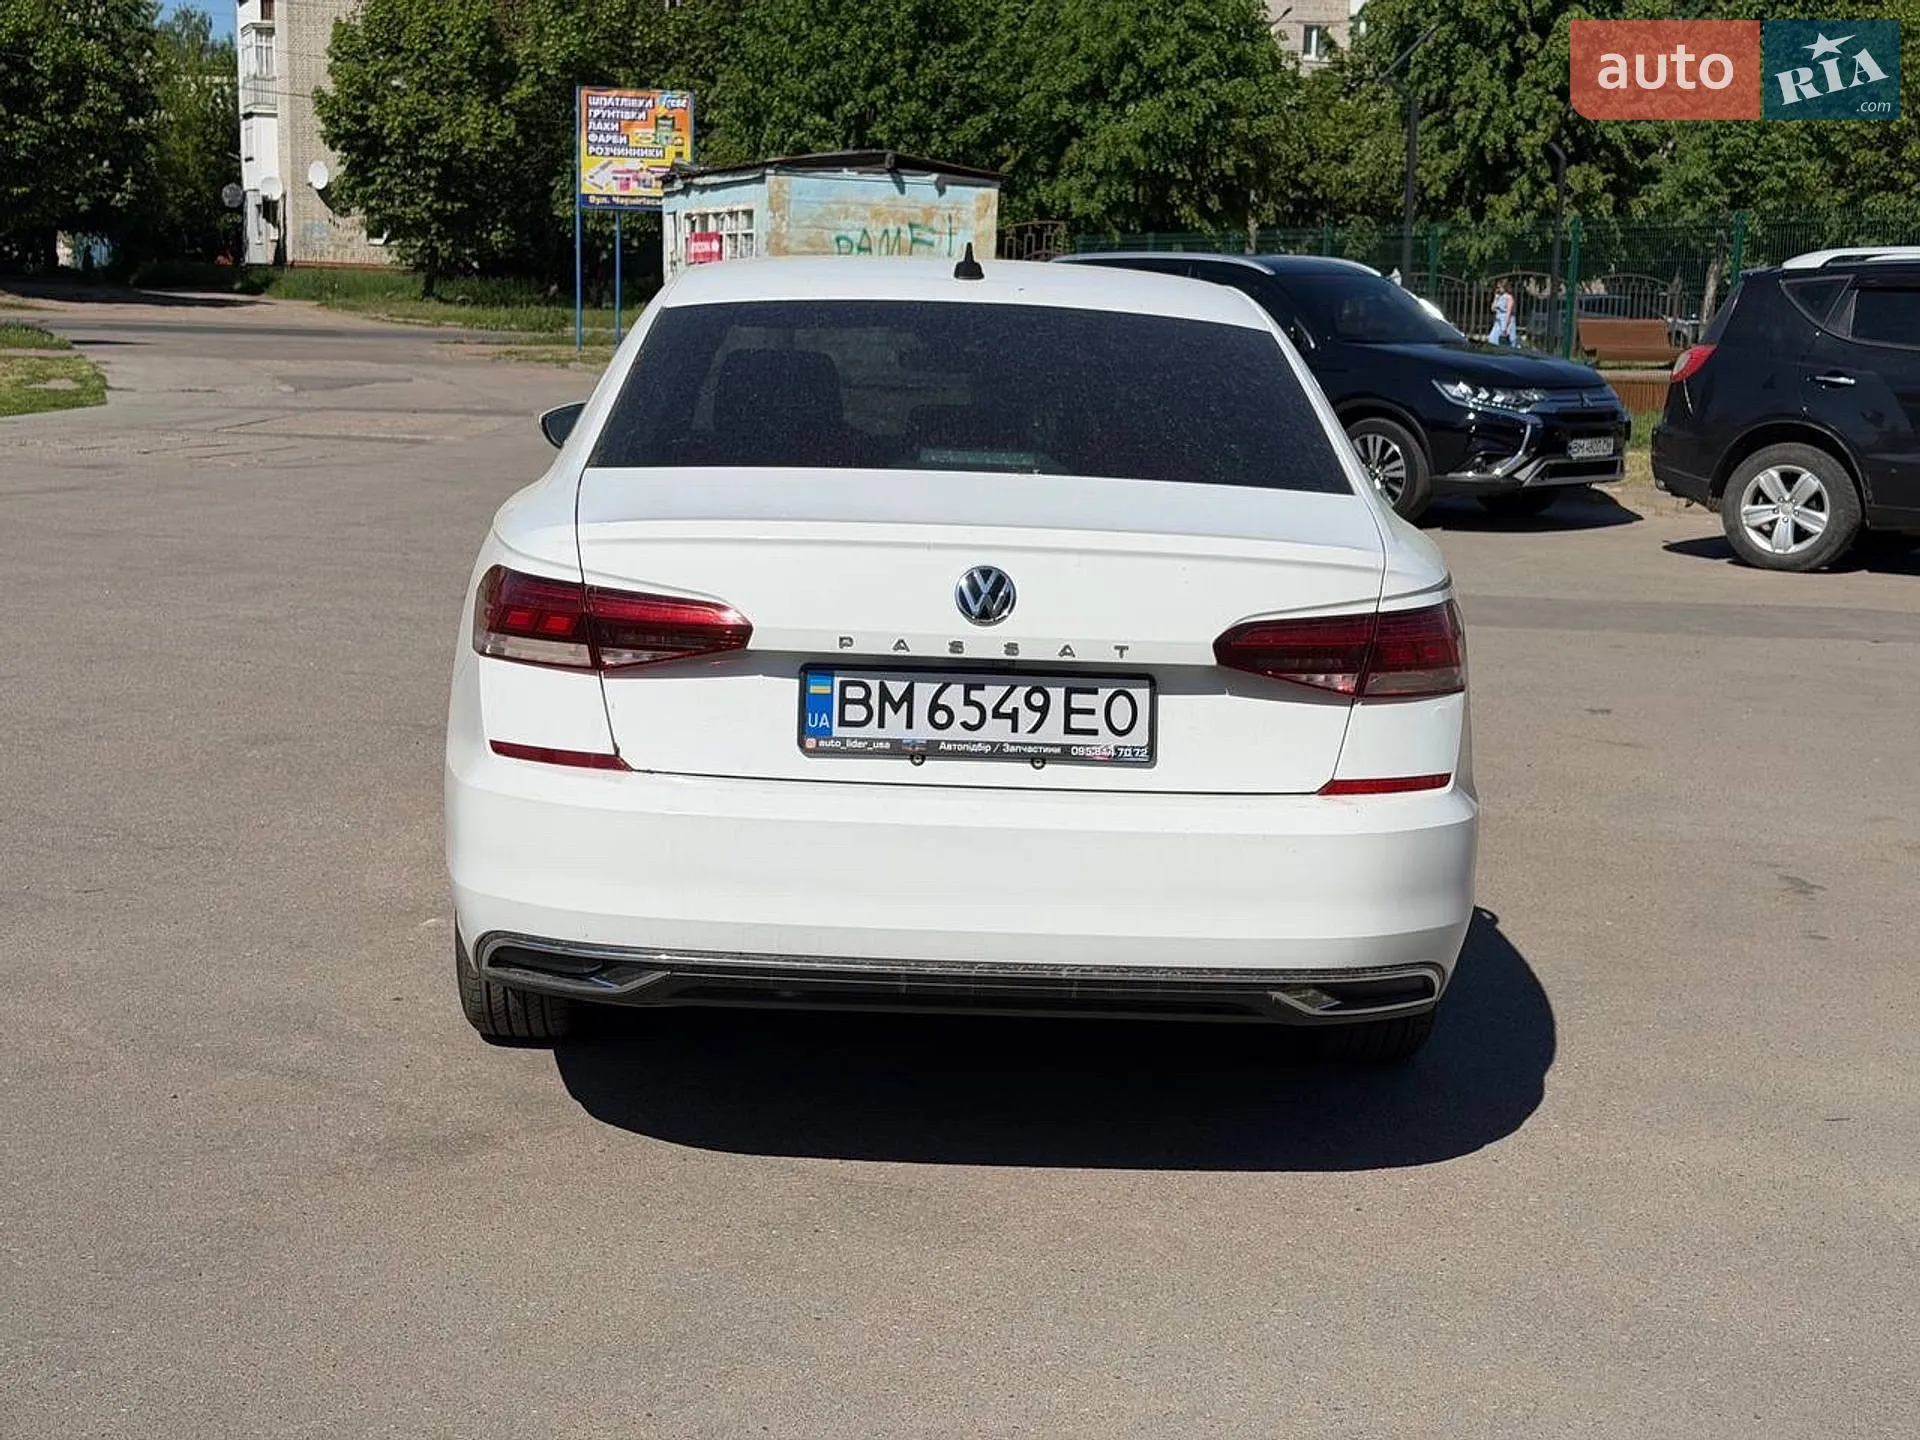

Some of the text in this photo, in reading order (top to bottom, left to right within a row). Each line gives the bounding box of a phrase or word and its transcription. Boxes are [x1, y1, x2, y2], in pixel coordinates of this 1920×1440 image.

[588, 133, 627, 144] ФАРБИ
[588, 145, 664, 157] РОЗЧИННИКИ
[838, 635, 1130, 659] PASSAT
[837, 679, 1139, 737] BM 6549 EO
[808, 712, 830, 729] UA
[818, 739, 891, 751] auto_lider_usa
